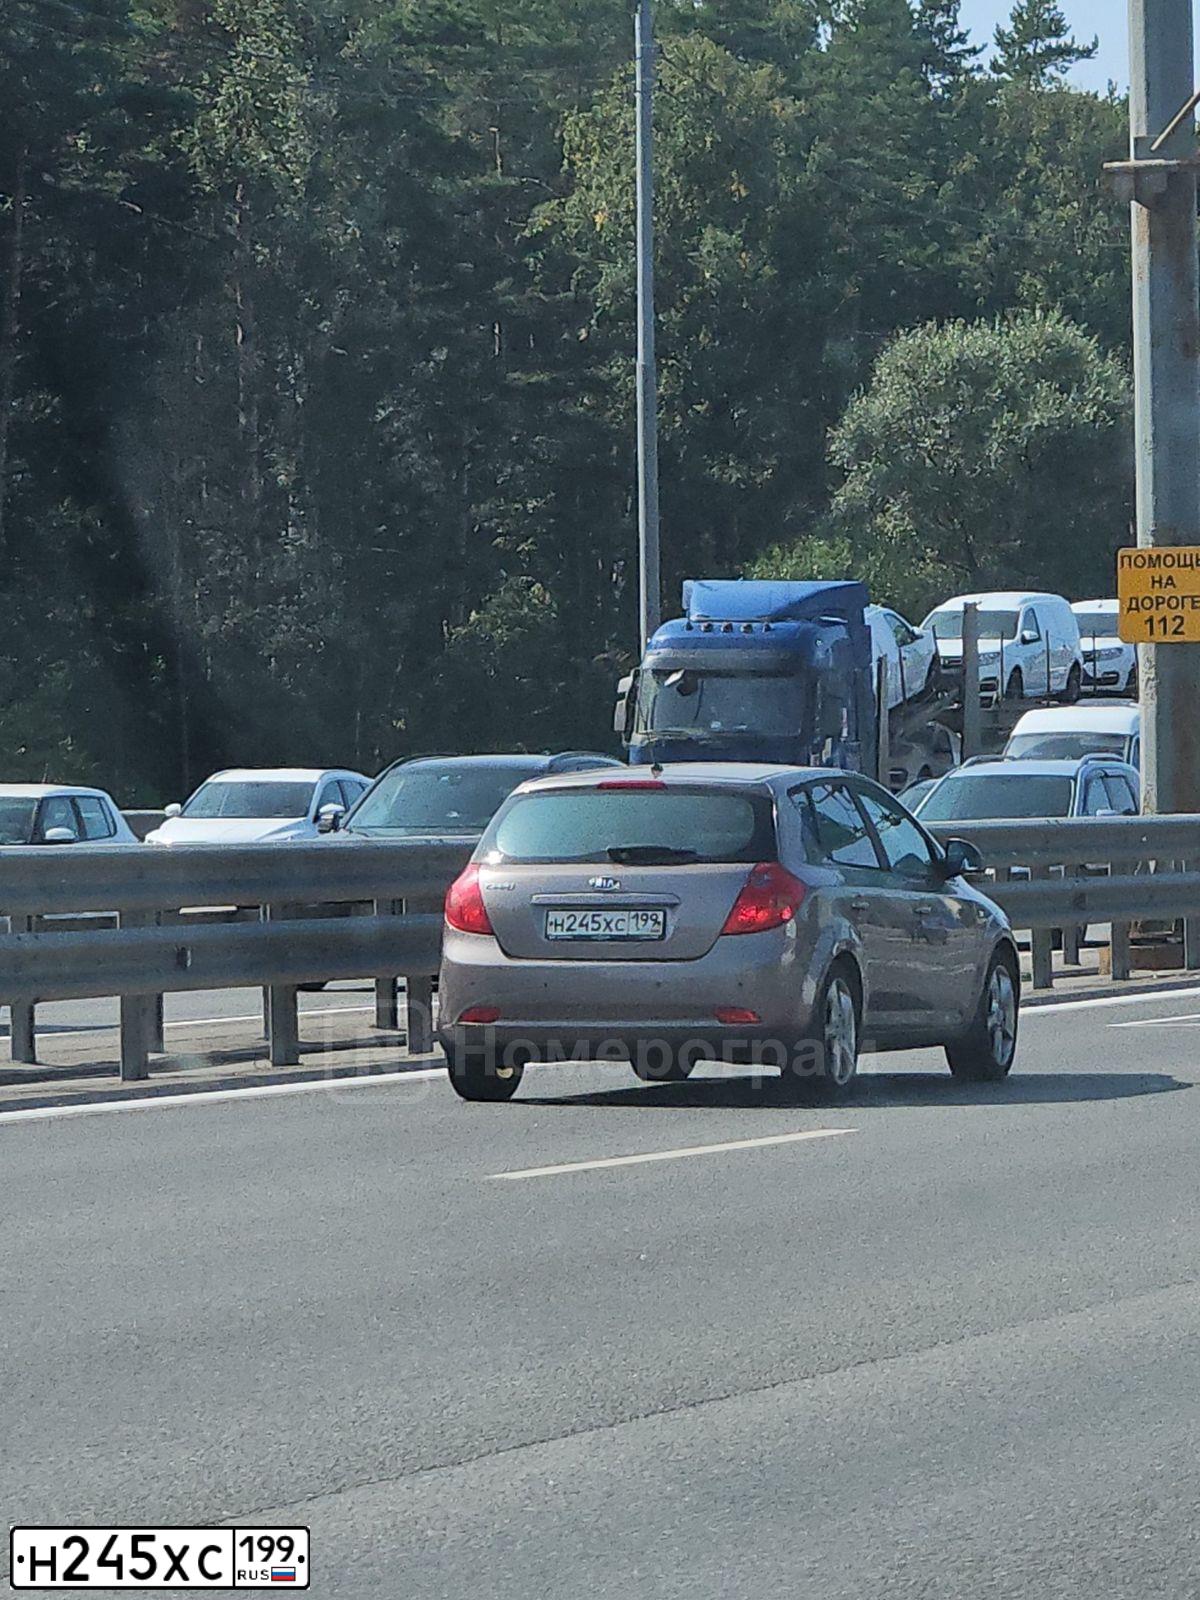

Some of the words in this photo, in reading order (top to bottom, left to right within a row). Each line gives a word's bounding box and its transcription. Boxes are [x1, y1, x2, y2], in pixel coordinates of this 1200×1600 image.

[1151, 575, 1176, 589] НА
[1127, 595, 1200, 613] ДОРОГЕ
[1144, 615, 1185, 636] 112
[632, 913, 659, 931] 199
